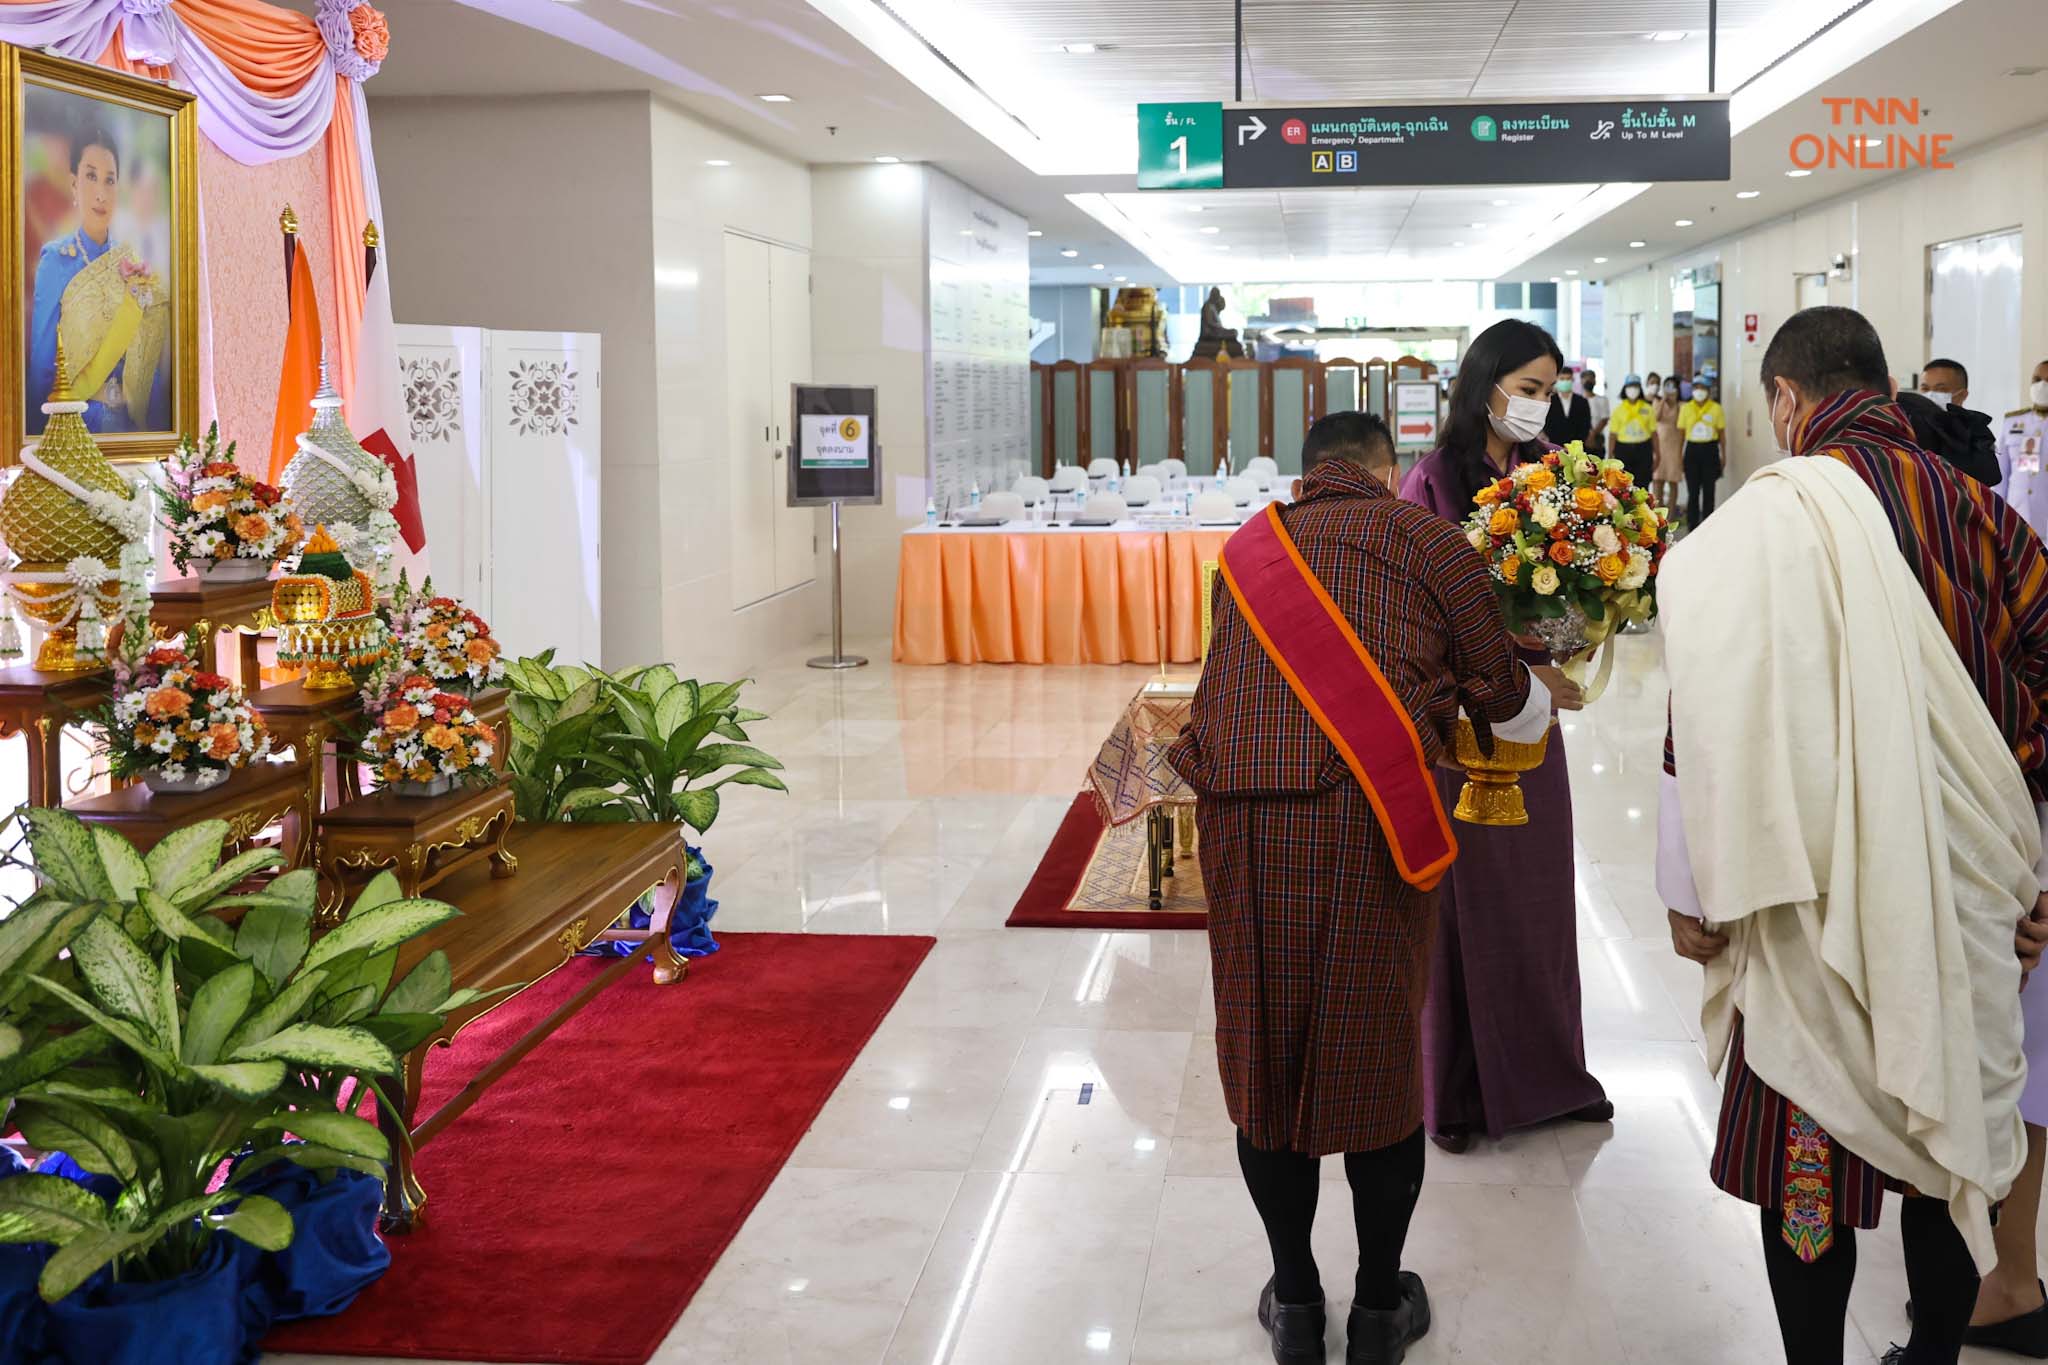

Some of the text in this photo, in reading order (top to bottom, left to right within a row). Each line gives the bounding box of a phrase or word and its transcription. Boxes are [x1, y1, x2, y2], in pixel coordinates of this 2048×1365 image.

[1186, 117, 1197, 126] FL
[1502, 115, 1570, 131] ลงทะเบียน
[1682, 115, 1696, 127] M
[1286, 126, 1301, 137] ER
[1621, 130, 1684, 140] Up To M Level
[1311, 135, 1405, 146] Emergency Department
[1501, 133, 1535, 143] Register
[1169, 135, 1188, 175] 1
[1315, 155, 1329, 169] A
[1340, 154, 1353, 169] B
[846, 422, 855, 438] 6
